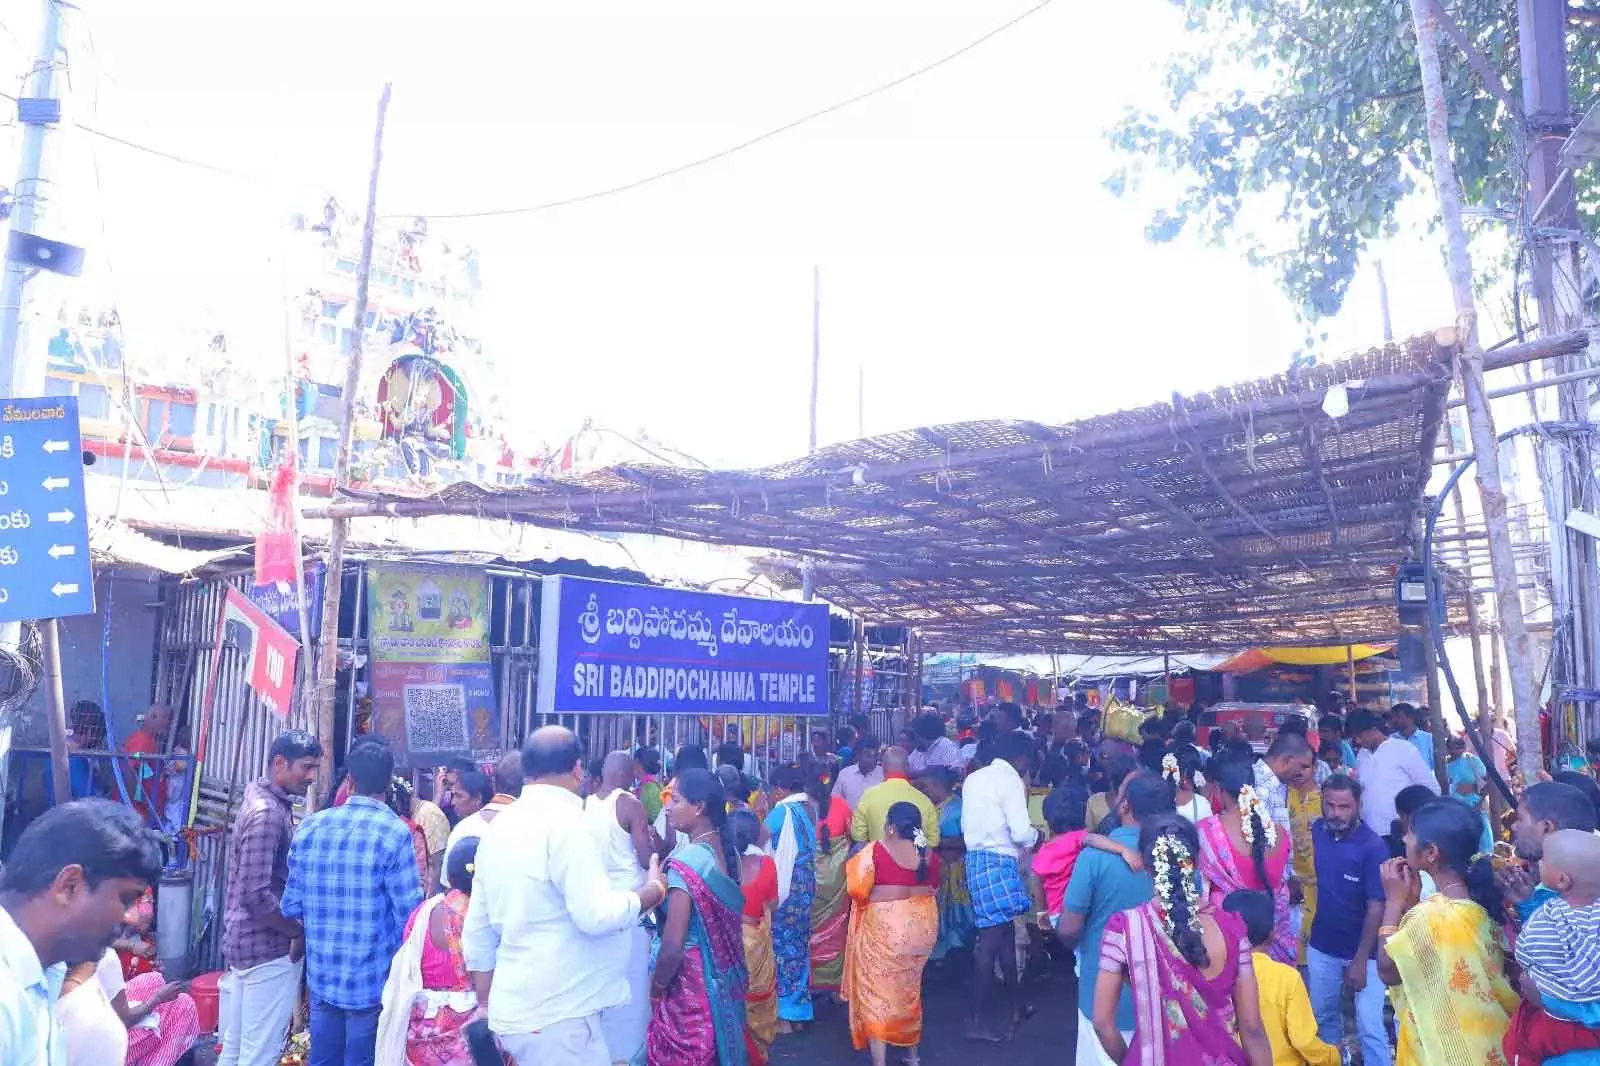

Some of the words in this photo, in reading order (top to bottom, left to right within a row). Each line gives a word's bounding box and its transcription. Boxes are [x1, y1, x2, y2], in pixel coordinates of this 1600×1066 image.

[578, 592, 600, 644] శ్రీ
[721, 608, 814, 649] దేవాలయం
[573, 662, 604, 697] SRI
[610, 665, 755, 701] BADDIPOCHAMMA
[760, 672, 816, 703] TEMPLE
